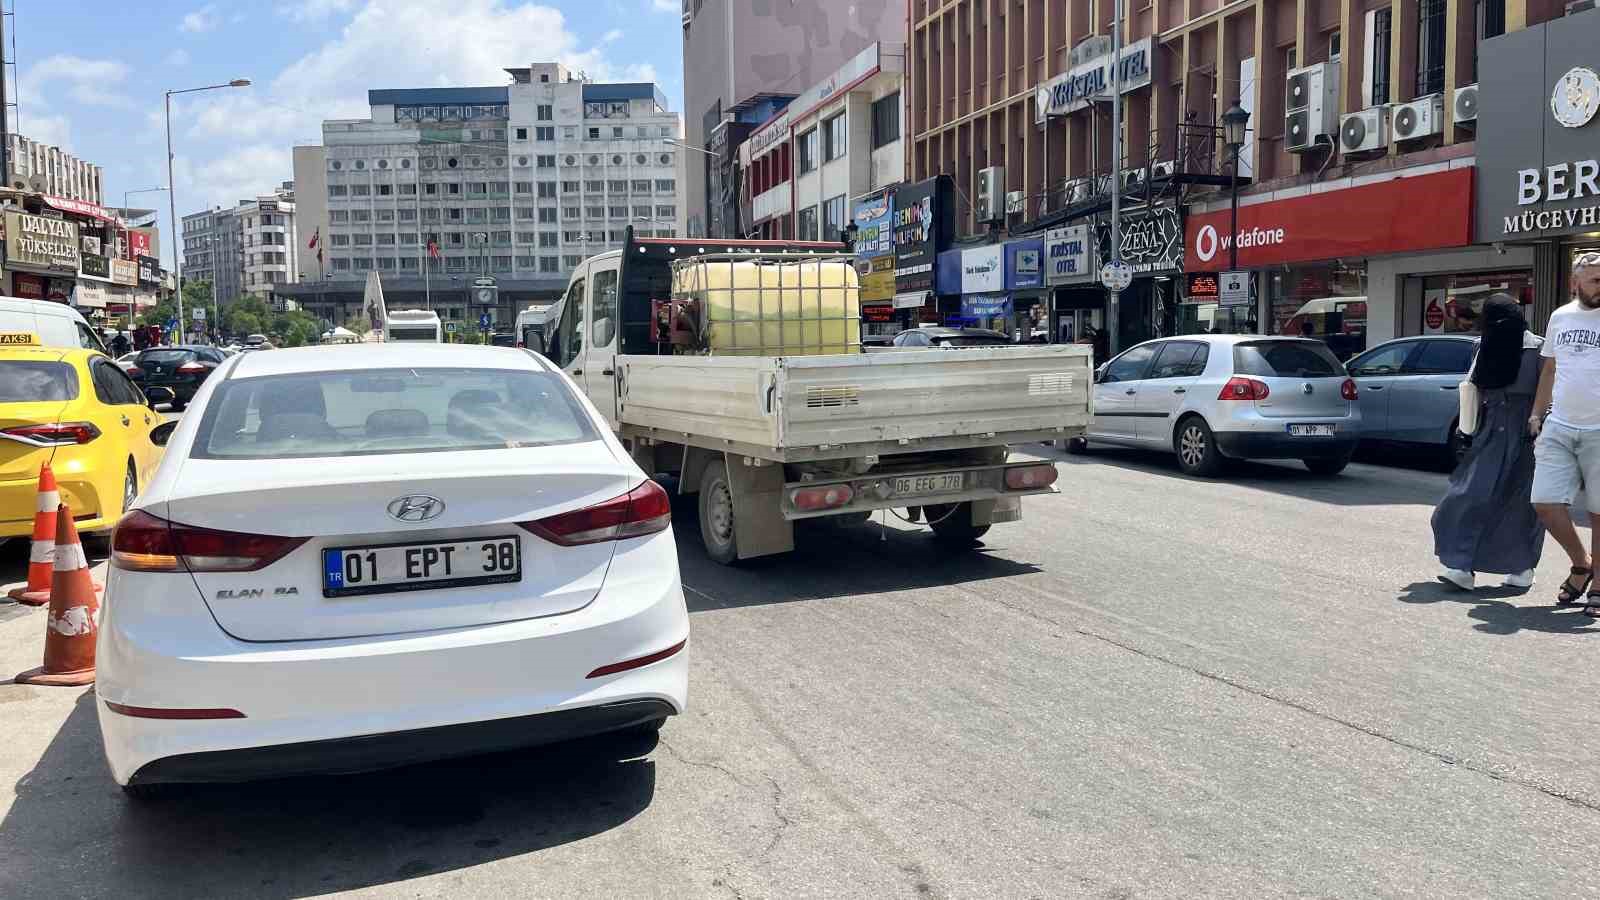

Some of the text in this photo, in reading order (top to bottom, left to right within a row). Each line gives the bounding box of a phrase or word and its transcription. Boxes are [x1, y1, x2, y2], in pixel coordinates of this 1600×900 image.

[1051, 66, 1106, 109] KRİSTAL
[1518, 160, 1600, 205] BER
[22, 214, 73, 239] DALYAN
[1503, 206, 1600, 233] MÜCEVH
[19, 235, 78, 258] YÜKSELLER
[1051, 240, 1083, 258] KRİSTAL
[1126, 231, 1157, 251] ZENA
[1056, 259, 1077, 273] OTEL
[897, 479, 910, 492] 06
[329, 542, 514, 583] TR 01 EPT 38
